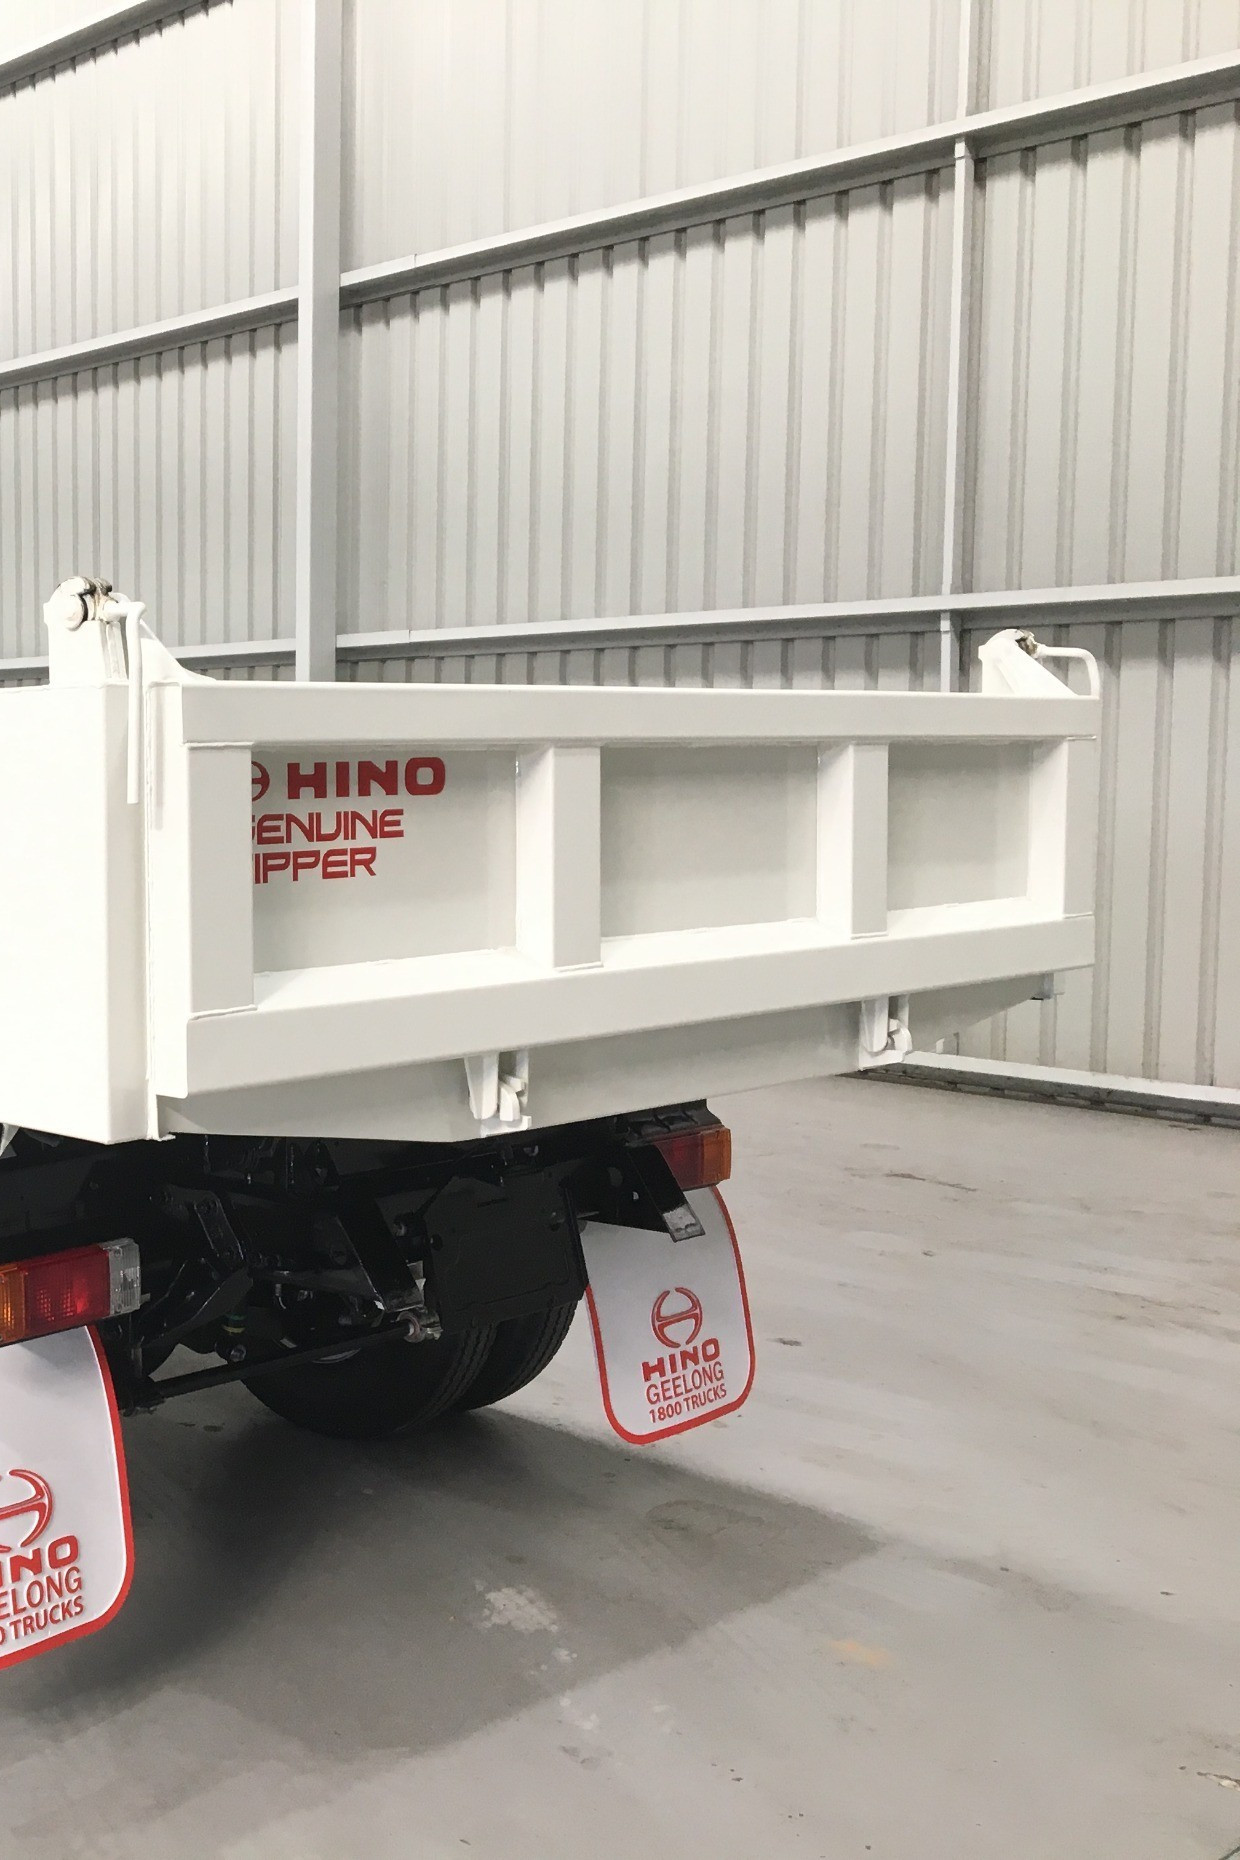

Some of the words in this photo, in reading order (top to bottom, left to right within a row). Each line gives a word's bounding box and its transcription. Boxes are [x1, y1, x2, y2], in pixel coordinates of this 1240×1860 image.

[287, 757, 446, 799] HINO
[252, 808, 405, 845] ENUINE
[252, 846, 377, 884] IPPER
[642, 1338, 721, 1382] HINO
[646, 1361, 725, 1405] GEELONG
[649, 1401, 683, 1423] 1800
[683, 1383, 727, 1412] TRUCKS
[8, 1595, 85, 1639] TRUCKS
